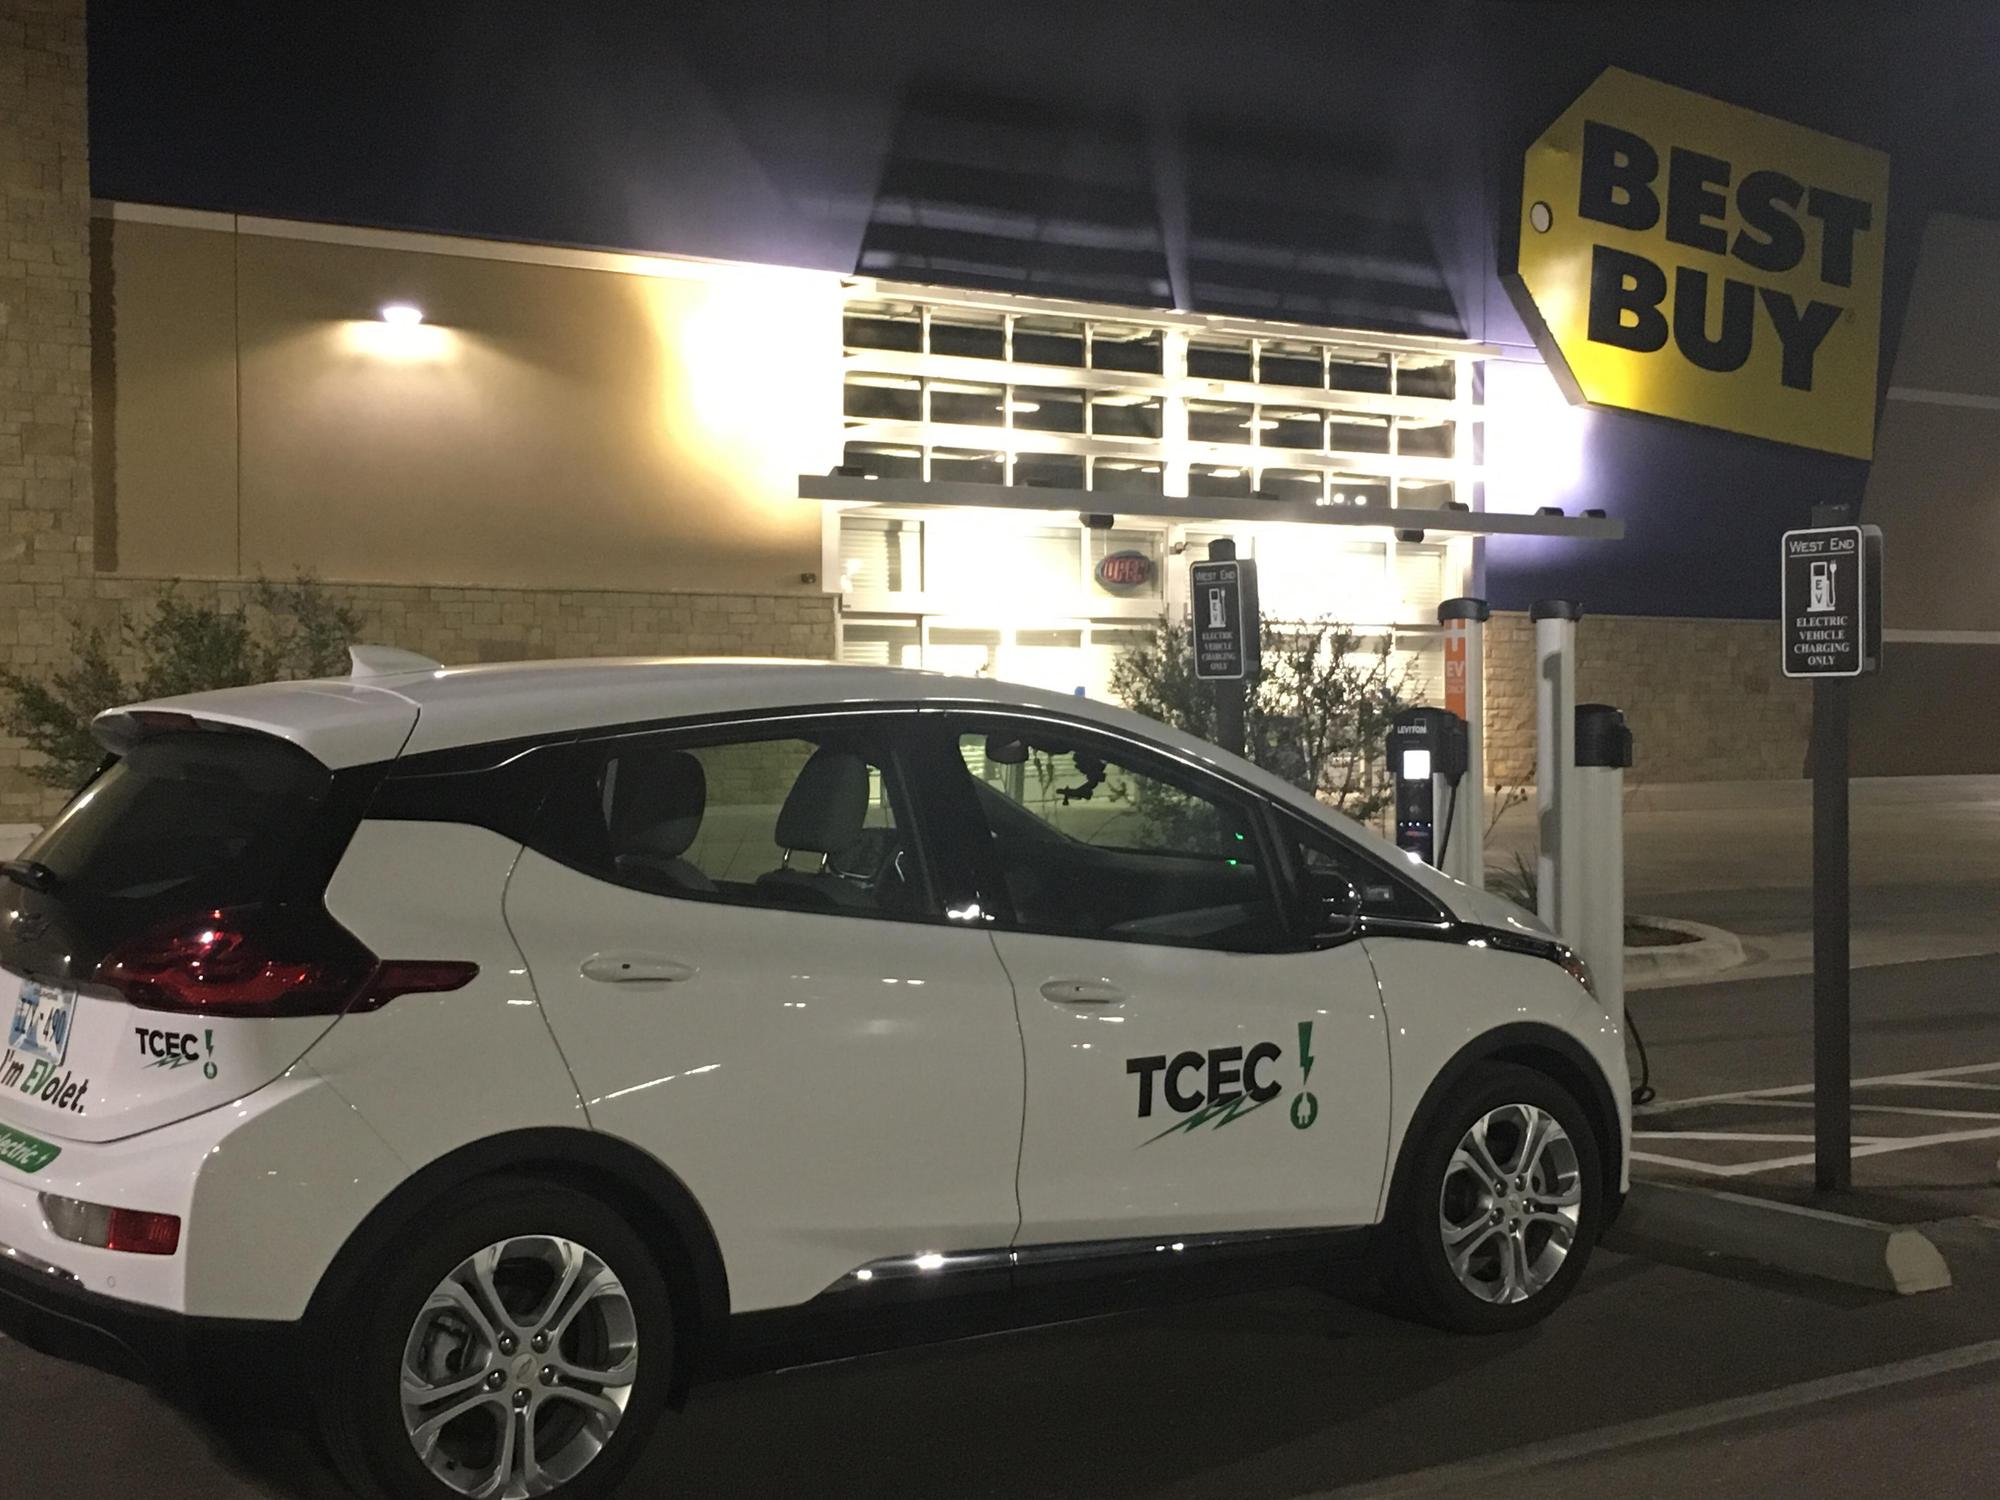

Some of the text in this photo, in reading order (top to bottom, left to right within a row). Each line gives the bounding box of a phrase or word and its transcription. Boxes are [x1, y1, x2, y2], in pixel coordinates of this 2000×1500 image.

[1578, 118, 1873, 289] BEST
[1587, 243, 1845, 393] BUY
[1789, 537, 1855, 553] WEST END
[1796, 616, 1849, 627] ELECTRIC
[1799, 630, 1845, 641] VEHICLE
[1794, 642, 1850, 654] CHARGING
[1808, 655, 1836, 666] ONLY
[1446, 661, 1465, 677] EV
[1397, 725, 1428, 734] LEVITON
[135, 1027, 200, 1061] TCEC
[0, 1048, 24, 1087] I'm
[1126, 1042, 1282, 1118] TCEC
